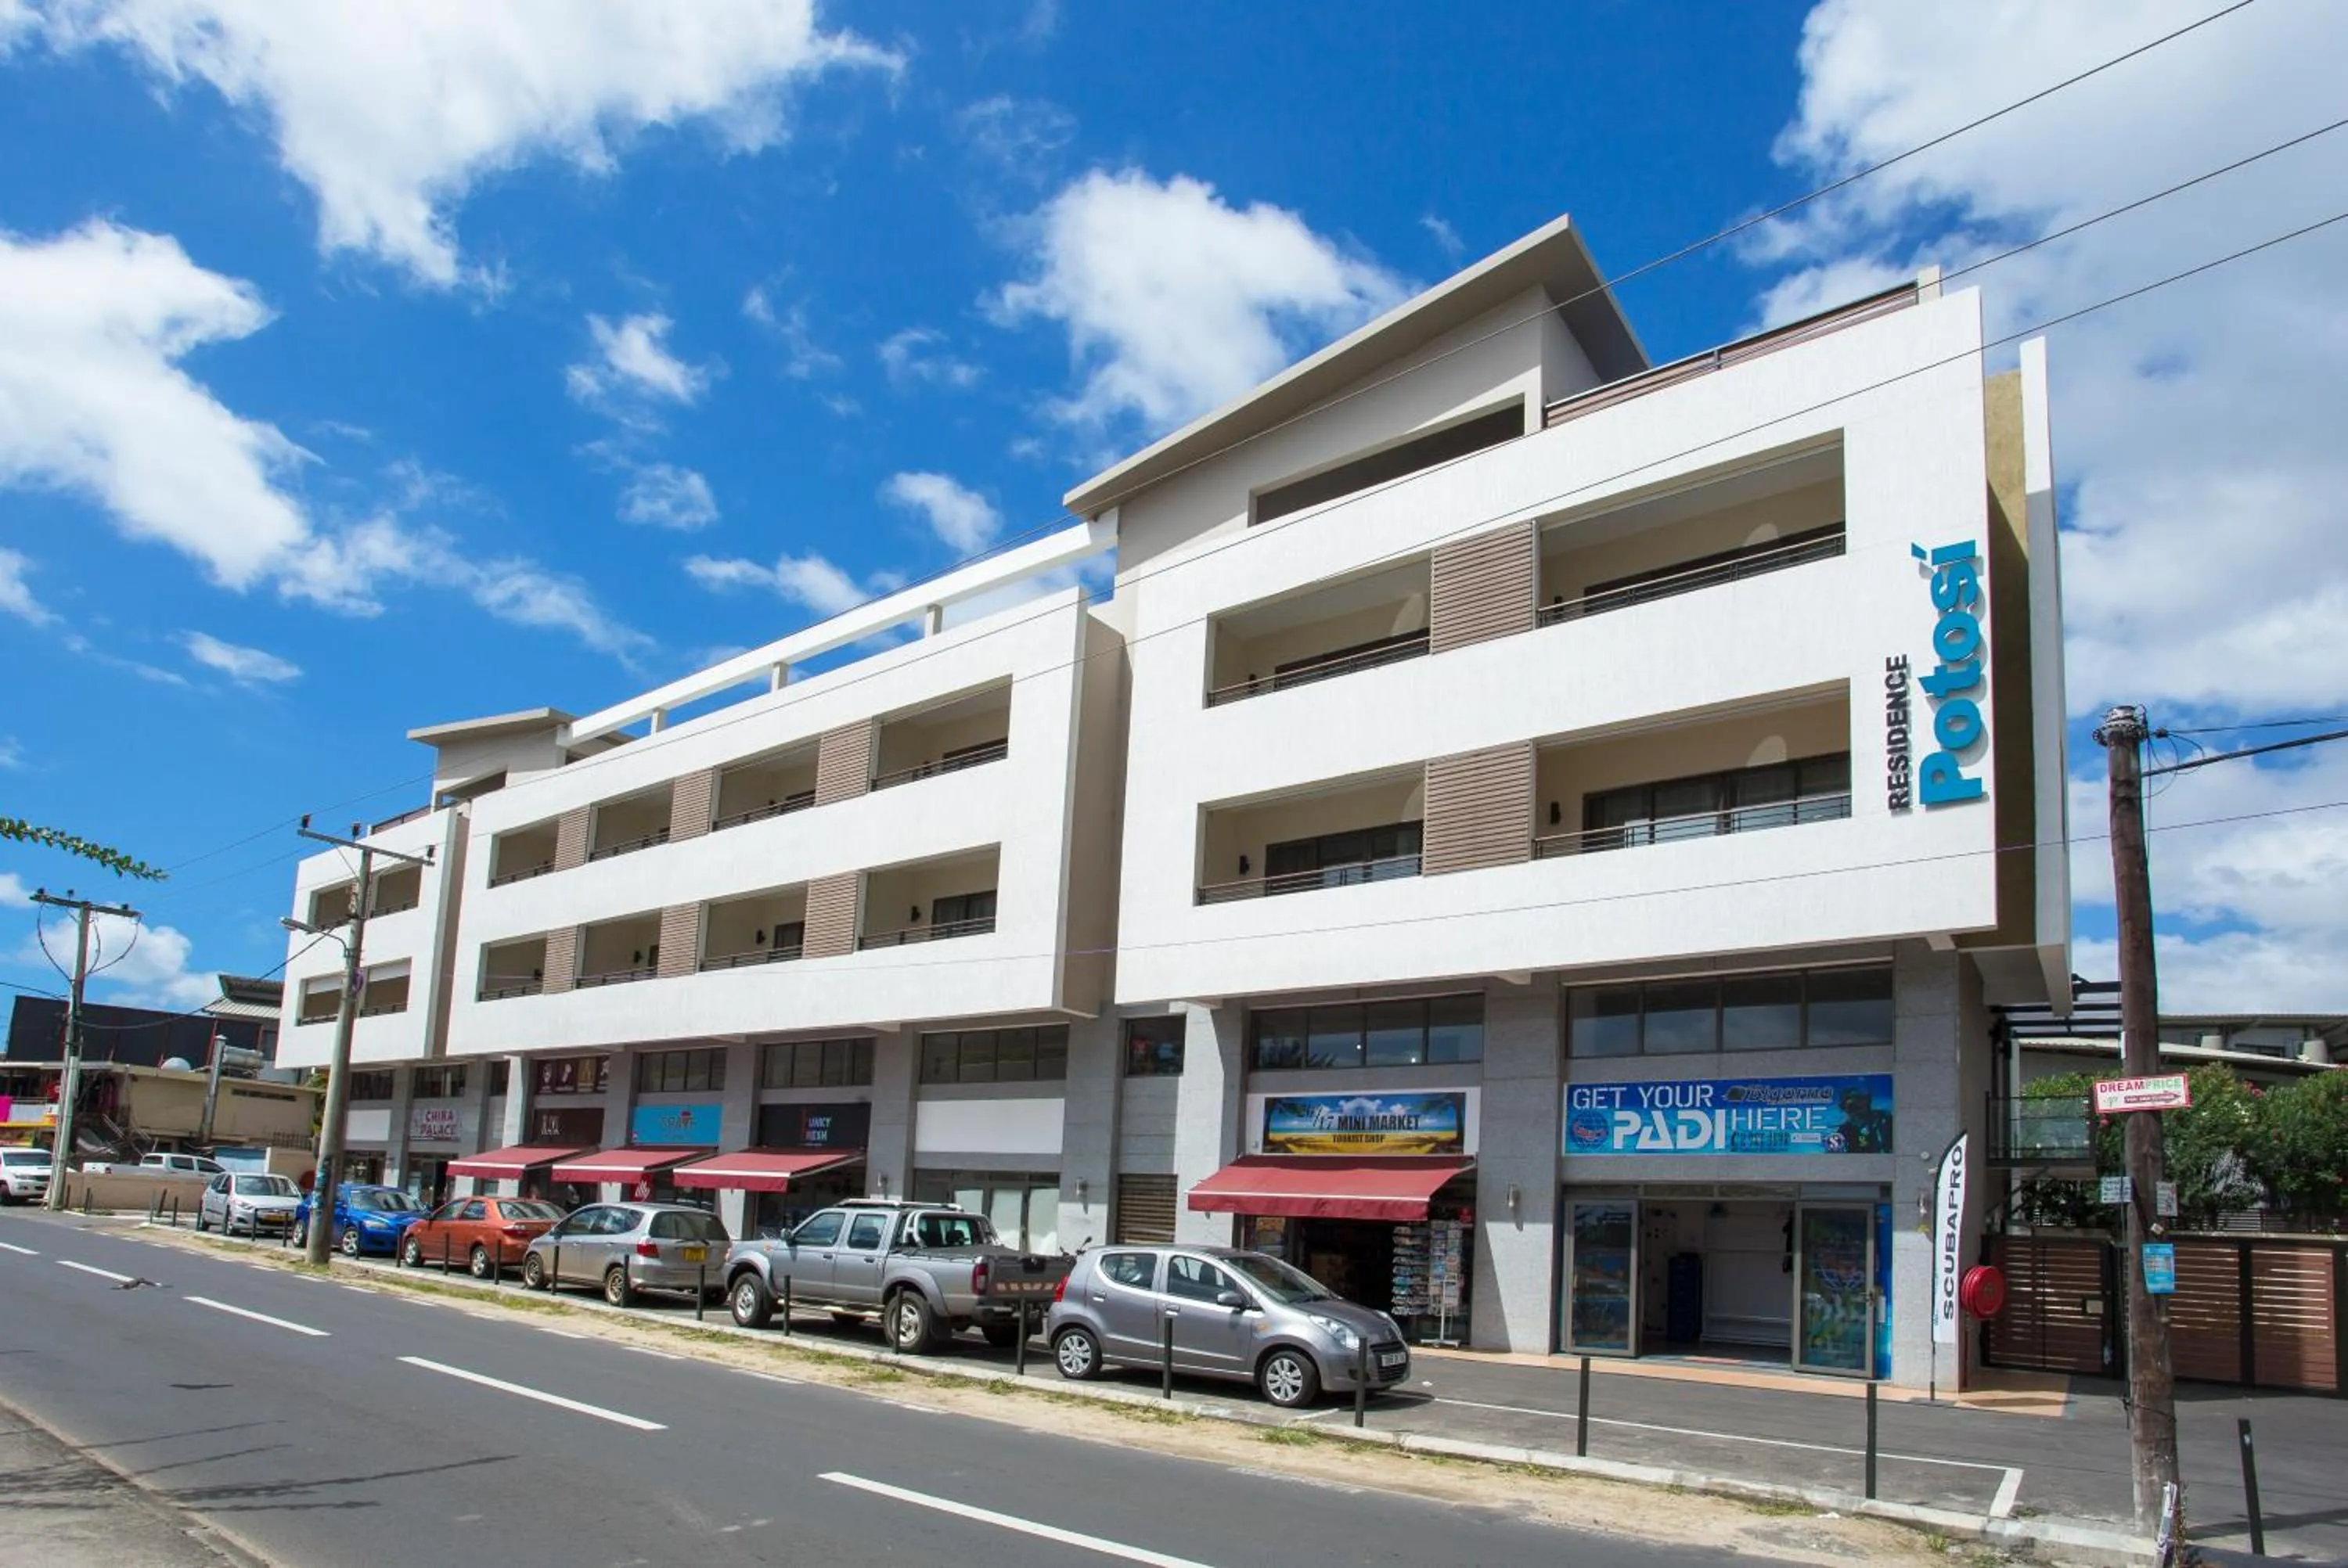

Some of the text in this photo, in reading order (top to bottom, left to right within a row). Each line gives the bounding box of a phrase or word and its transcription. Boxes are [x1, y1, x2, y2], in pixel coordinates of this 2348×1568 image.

[1911, 539, 1982, 804] Potosí
[1885, 653, 1910, 812] RESIDENCE
[1572, 1087, 1626, 1109] GET
[1637, 1084, 1713, 1108] YOUR
[1337, 1115, 1367, 1131] MINI
[1370, 1113, 1420, 1131] MARKET
[1614, 1109, 1726, 1149] PADI
[1731, 1107, 1828, 1131] HERE
[1943, 1145, 1963, 1320] SCUBAPRO
